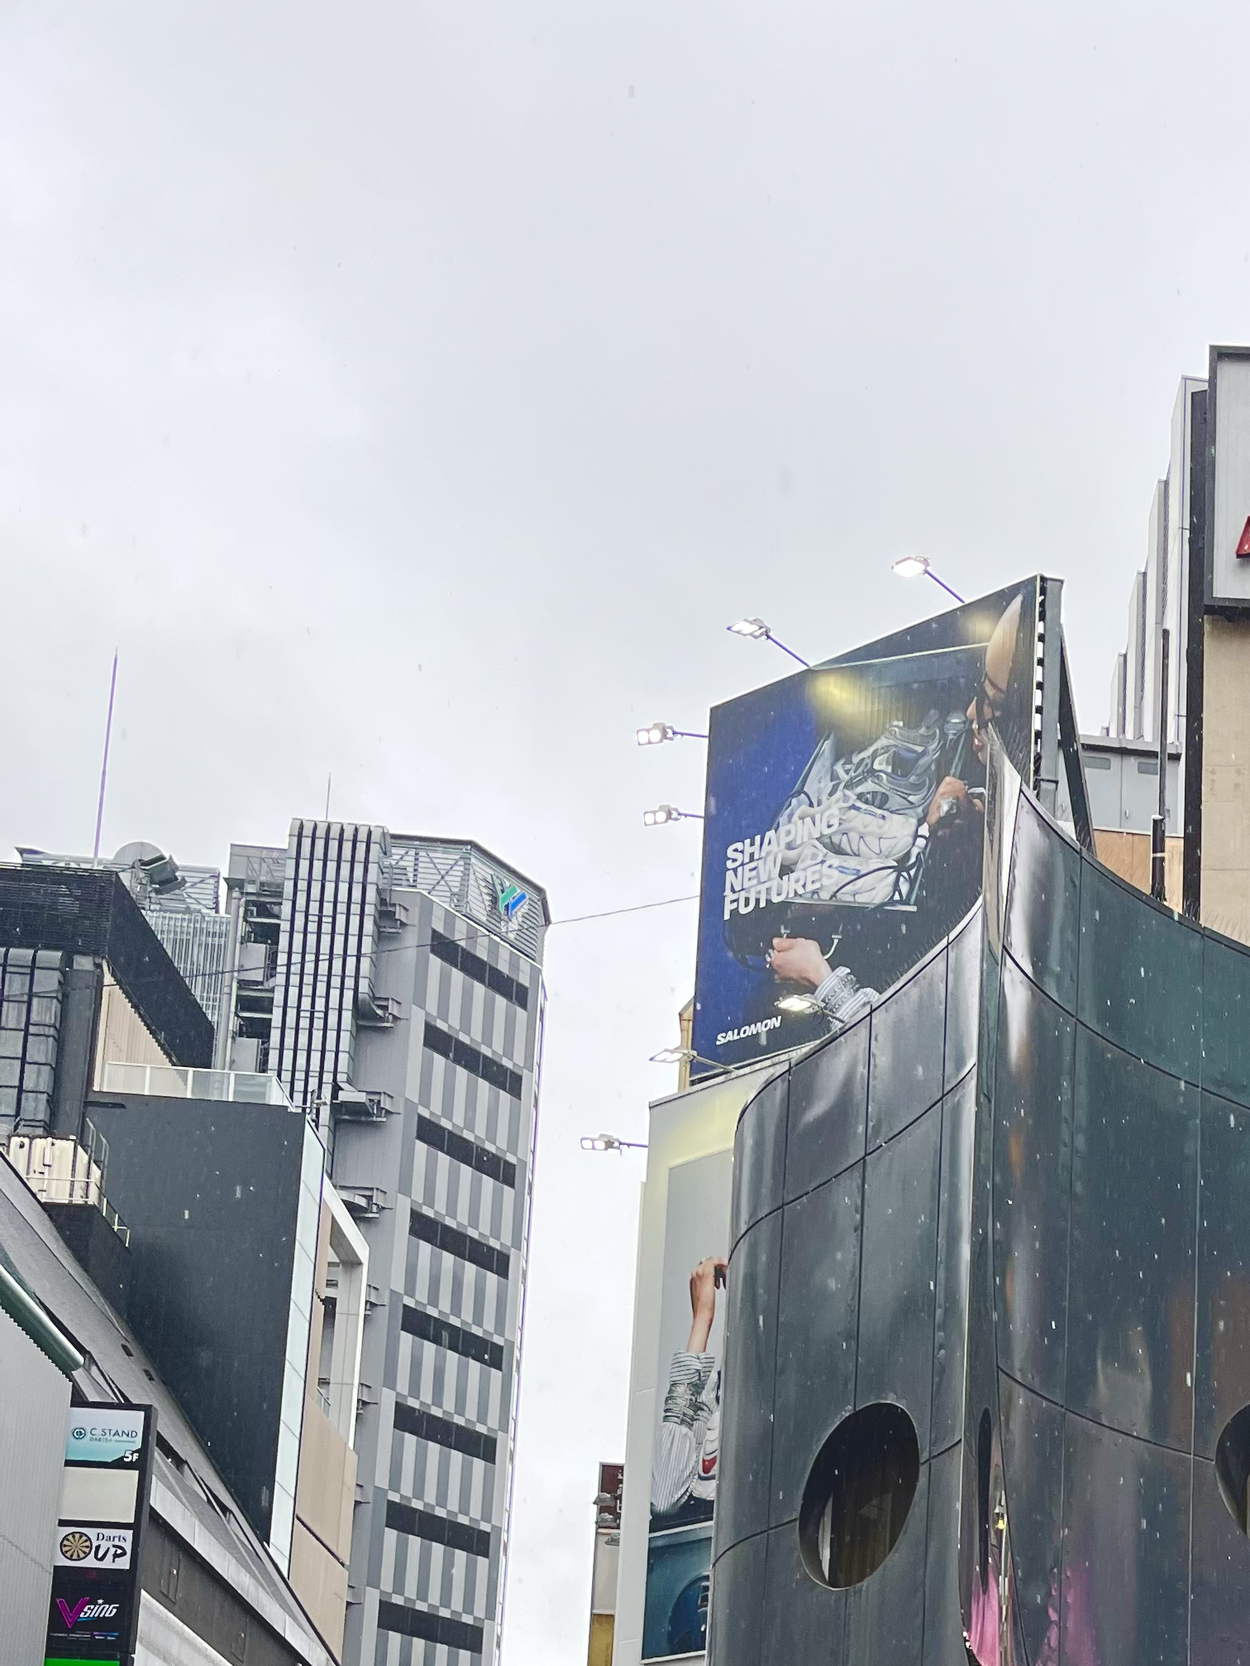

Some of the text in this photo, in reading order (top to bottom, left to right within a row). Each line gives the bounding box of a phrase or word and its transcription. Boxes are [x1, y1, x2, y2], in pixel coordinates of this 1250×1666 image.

[725, 810, 841, 868] SHAPING
[723, 854, 782, 897] NEW
[723, 860, 841, 921] FUTURES
[715, 1015, 782, 1046] SALOMON
[123, 1450, 139, 1462] 5F
[93, 1543, 128, 1563] UP
[96, 1532, 127, 1543] Darts
